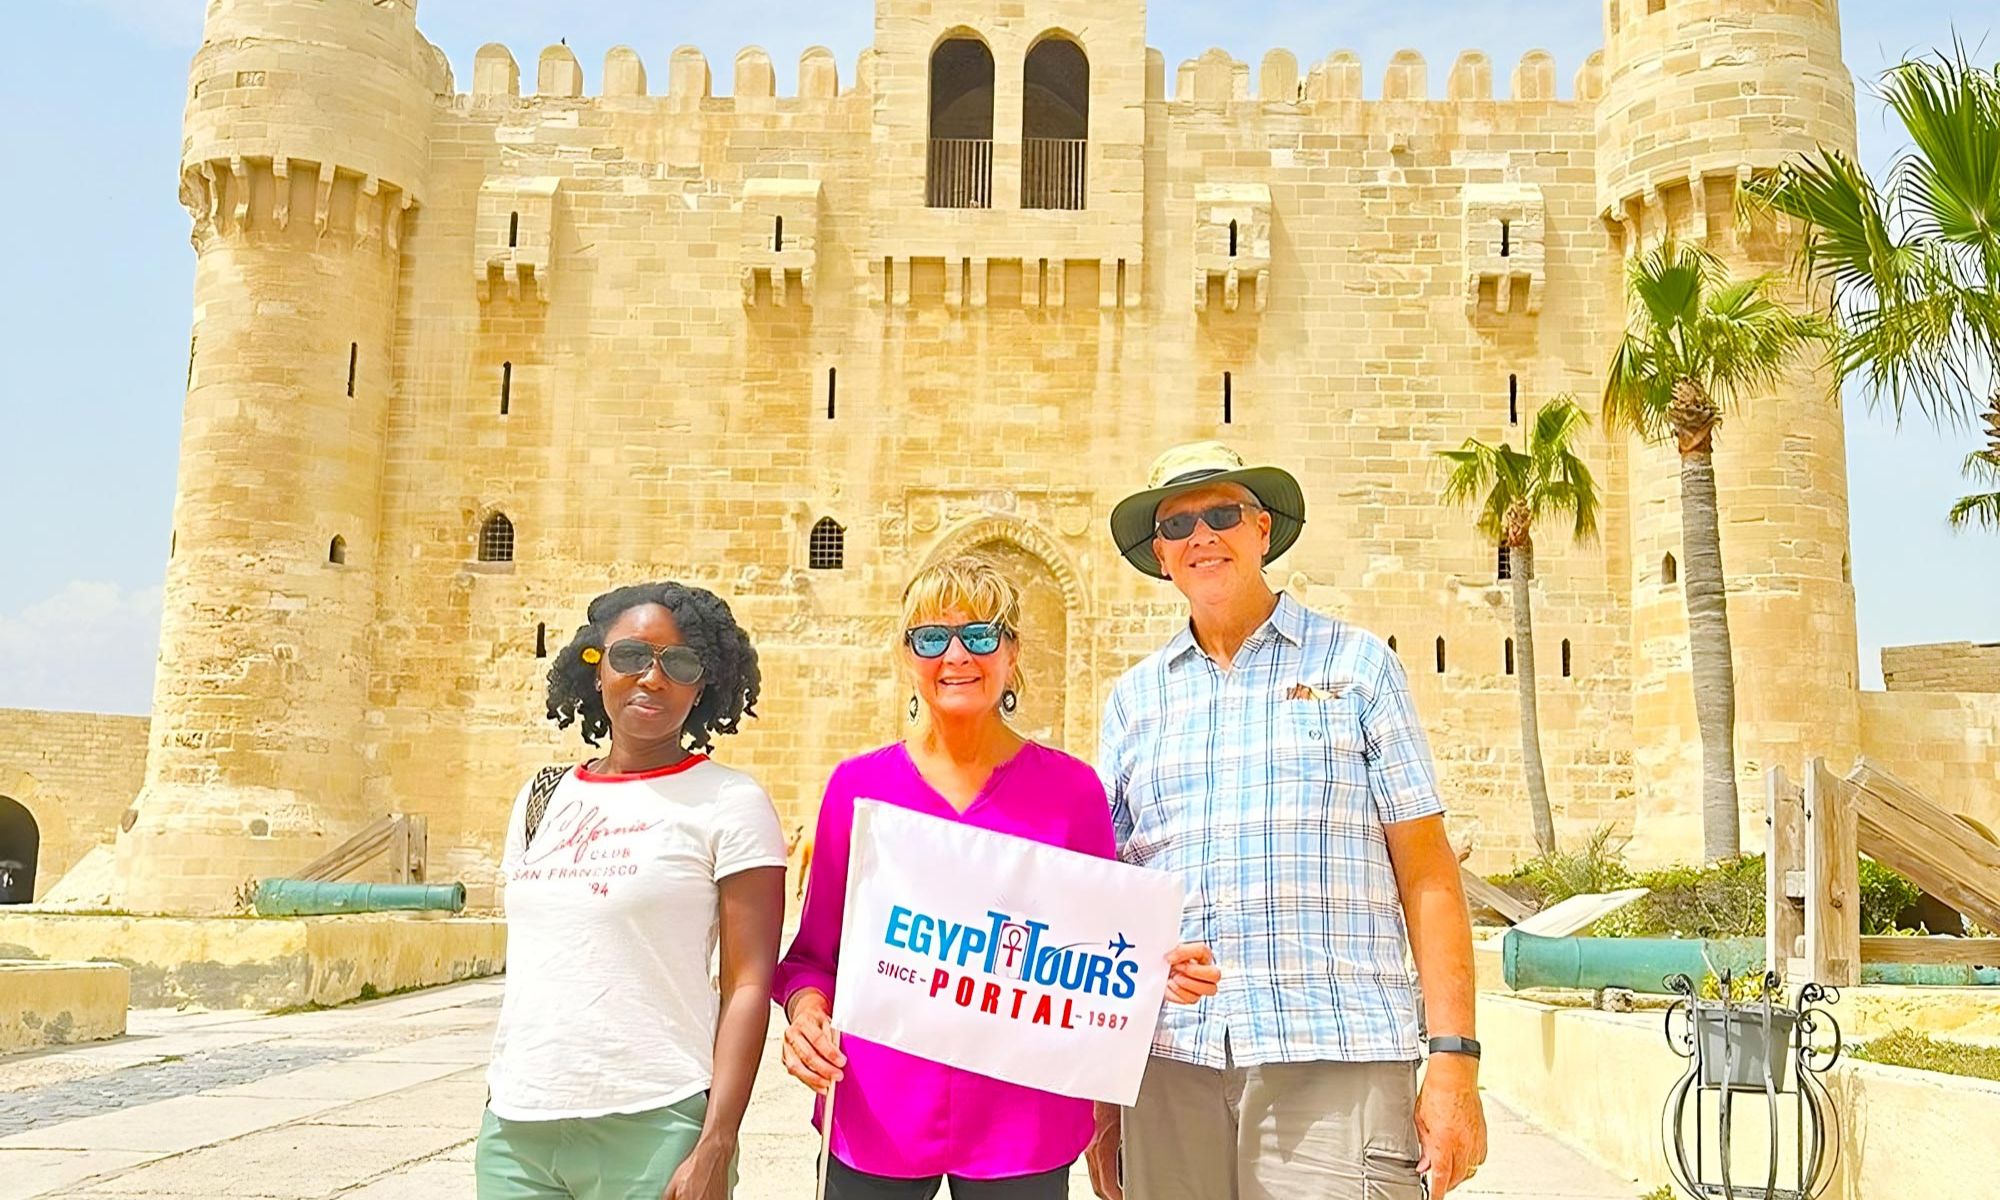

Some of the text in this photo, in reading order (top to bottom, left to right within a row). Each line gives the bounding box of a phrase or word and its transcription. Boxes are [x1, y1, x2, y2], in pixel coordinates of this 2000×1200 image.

[523, 799, 665, 864] California
[590, 847, 631, 860] CLUB
[512, 863, 638, 881] SAN FRANCISCO
[884, 905, 1139, 1000] EGYPT TOURS
[929, 968, 1075, 1030] PORTAL
